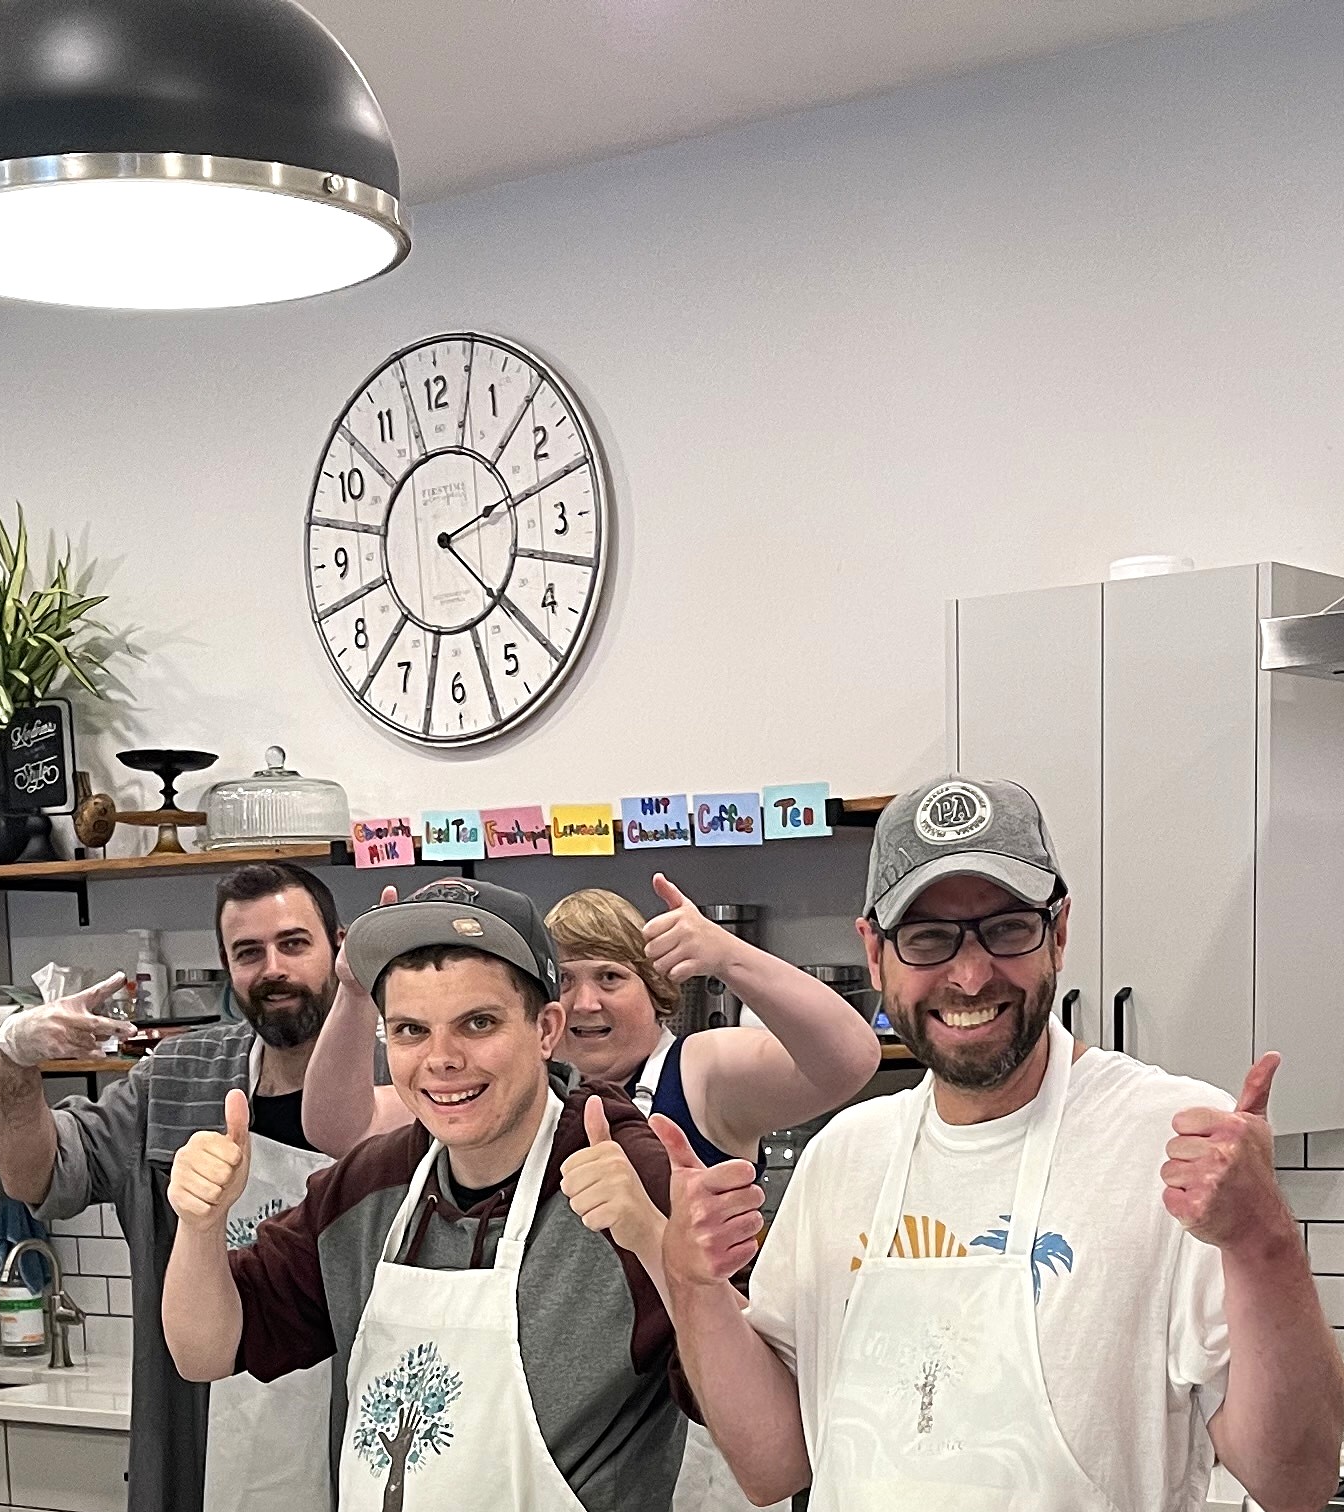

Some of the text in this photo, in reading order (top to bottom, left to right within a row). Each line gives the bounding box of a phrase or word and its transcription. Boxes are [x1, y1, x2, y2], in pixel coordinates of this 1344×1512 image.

[424, 374, 448, 411] 12
[488, 383, 498, 417] 1
[377, 408, 395, 443] 11
[533, 425, 550, 460] 2
[338, 467, 364, 502] 10
[554, 501, 568, 536] 3
[334, 547, 349, 579] 9
[541, 582, 557, 614] 4
[354, 617, 368, 650] 8
[504, 642, 519, 677] 5
[397, 661, 412, 694] 7
[451, 671, 466, 704] 6
[698, 803, 754, 834] Coffee
[774, 797, 814, 828] Tea
[452, 818, 478, 843] Tea
